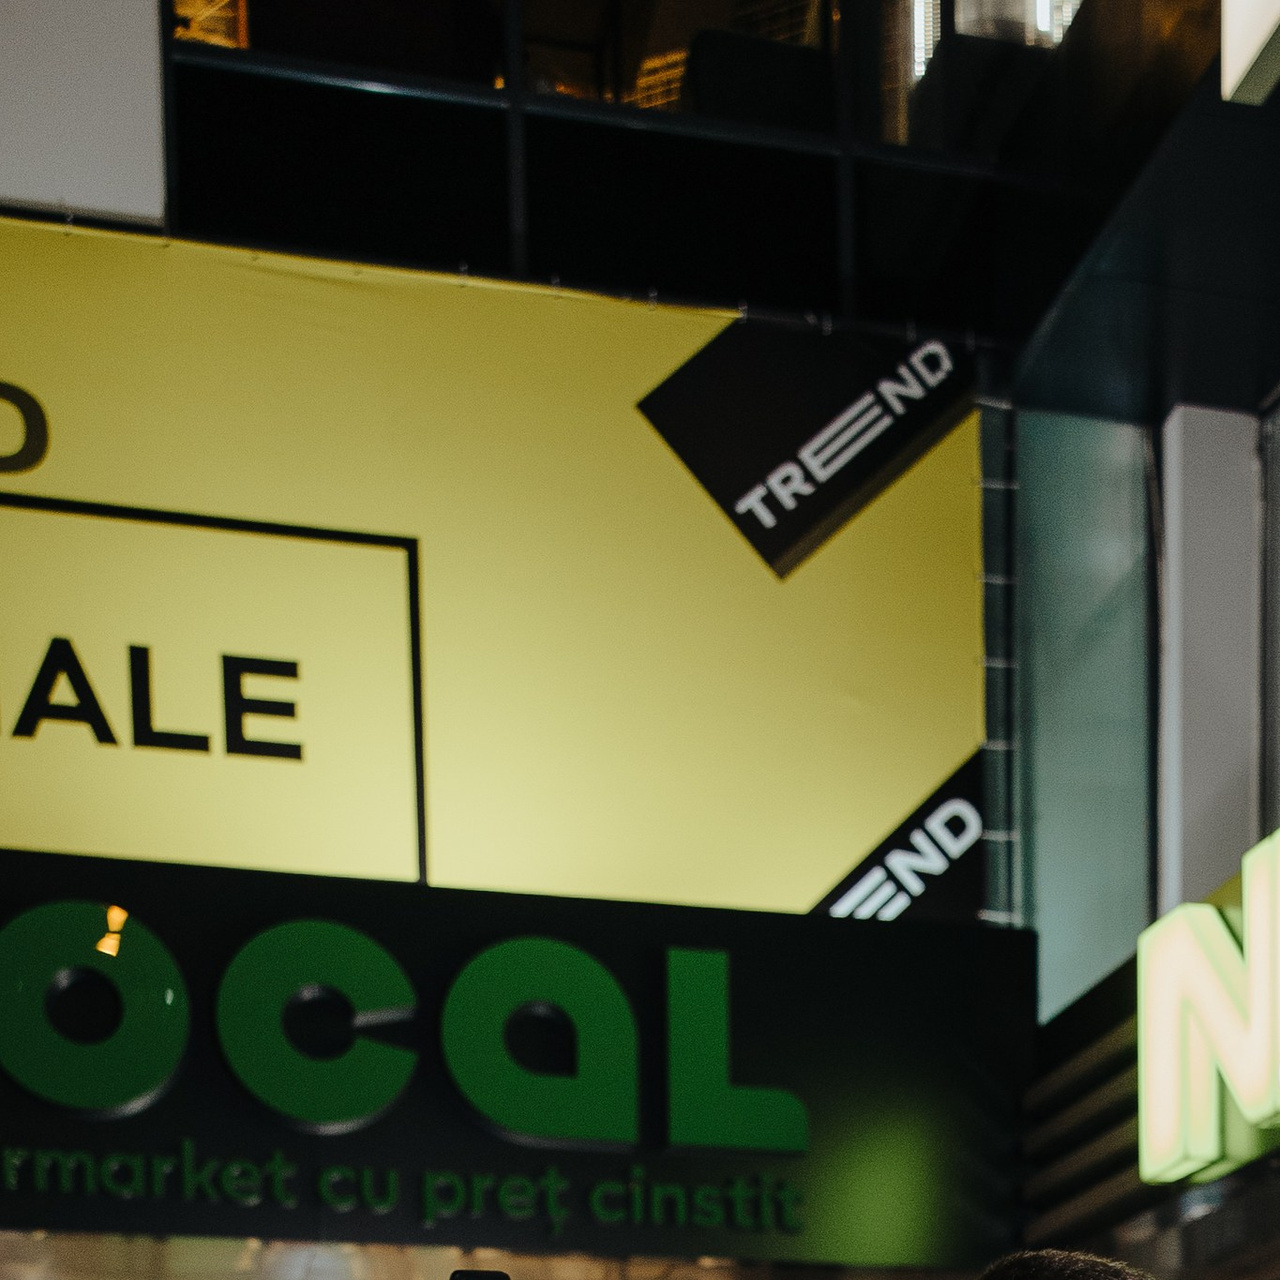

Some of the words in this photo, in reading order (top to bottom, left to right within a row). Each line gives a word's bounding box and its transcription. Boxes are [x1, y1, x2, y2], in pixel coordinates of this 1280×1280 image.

[734, 340, 954, 530] TREND
[12, 636, 304, 762] ALE
[317, 1164, 400, 1215] cu
